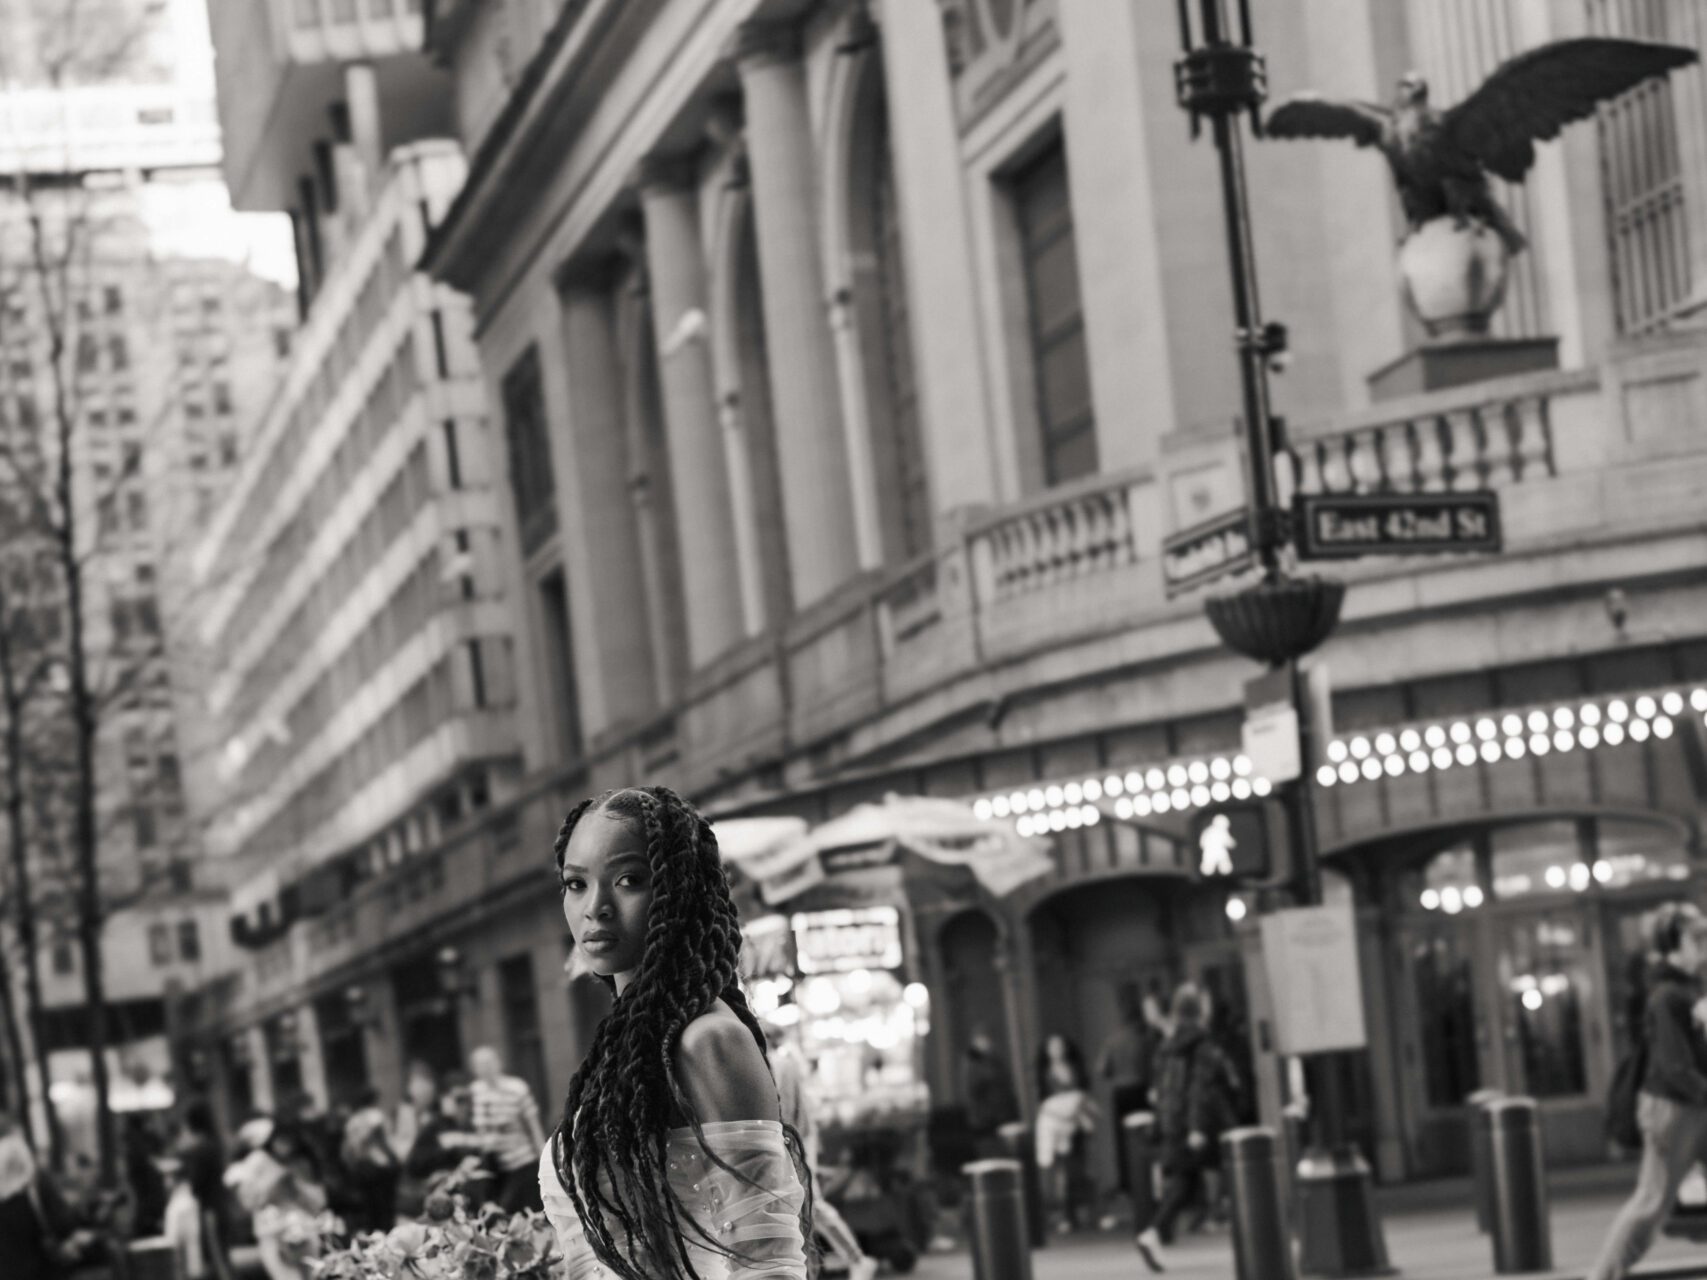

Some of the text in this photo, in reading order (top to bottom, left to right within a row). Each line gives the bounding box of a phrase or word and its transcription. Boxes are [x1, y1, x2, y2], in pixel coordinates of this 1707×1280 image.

[1319, 507, 1487, 542] East 42nd St
